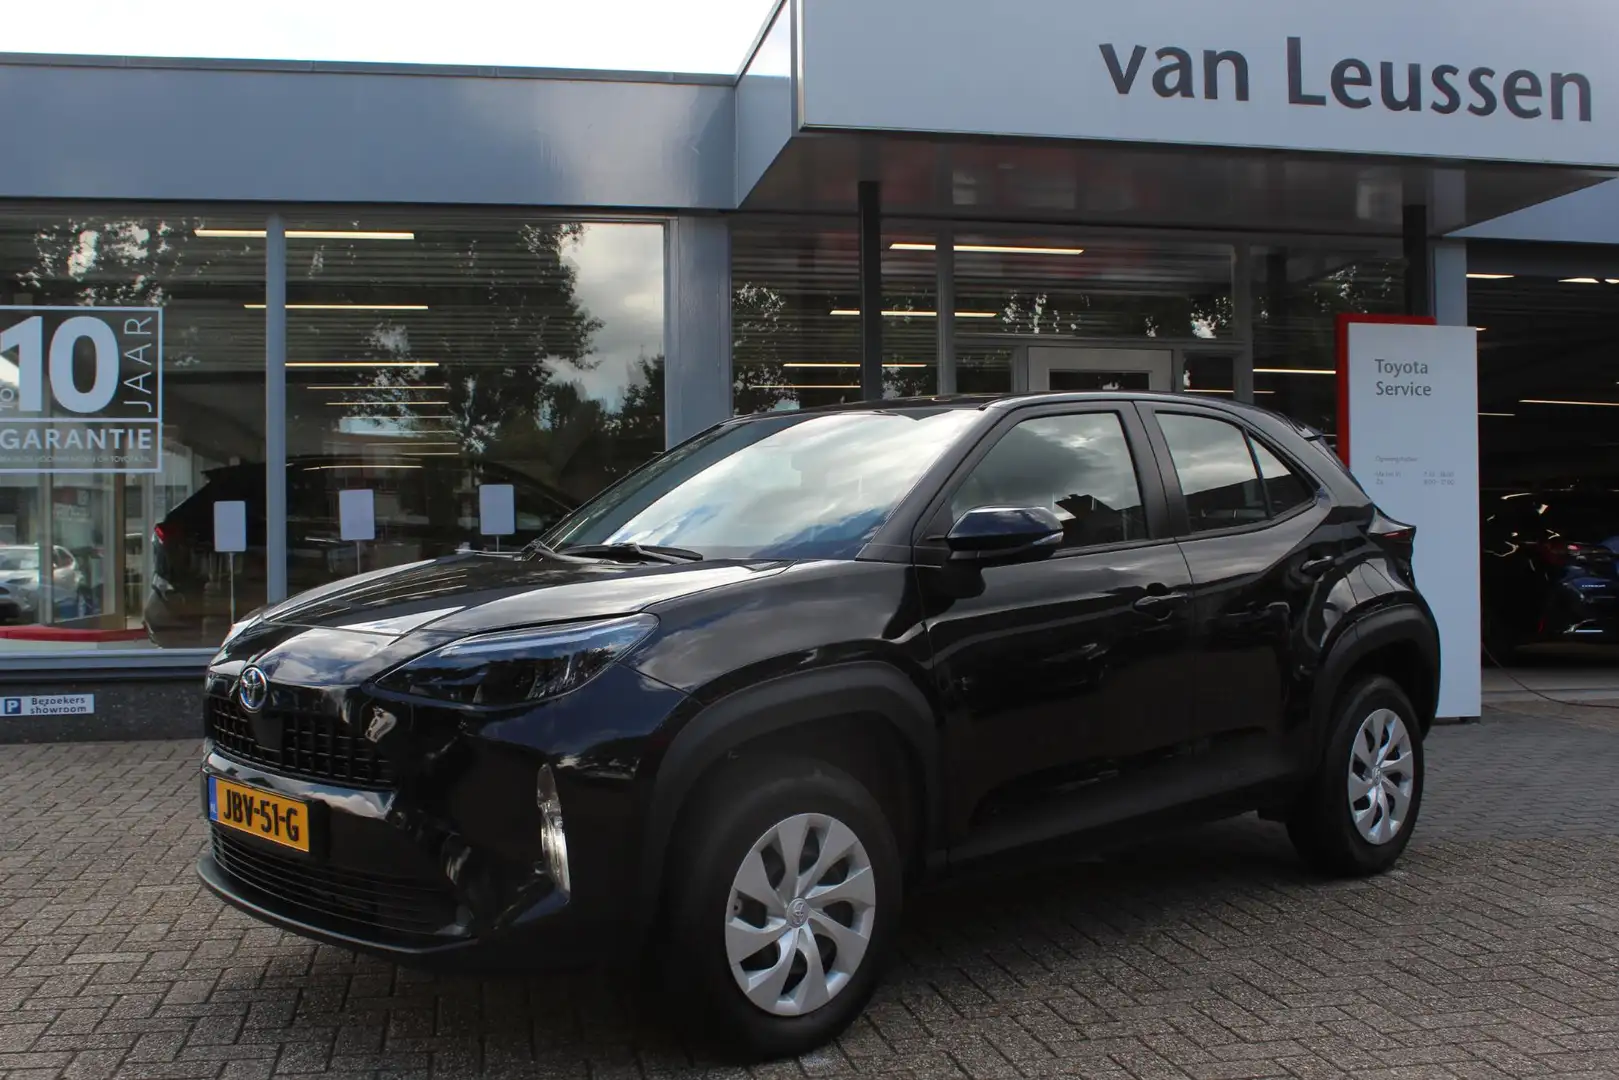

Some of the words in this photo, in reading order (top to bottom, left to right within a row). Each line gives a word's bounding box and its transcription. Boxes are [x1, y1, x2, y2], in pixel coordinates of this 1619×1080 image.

[1099, 43, 1249, 101] van
[1286, 36, 1592, 122] Leussen
[0, 316, 119, 413] 10
[123, 317, 152, 412] JAAR
[1374, 358, 1428, 378] Toyota
[1375, 380, 1432, 396] Service
[0, 428, 152, 450] GARANTIE
[6, 700, 19, 713] P
[30, 705, 87, 714] showroom
[32, 697, 86, 706] Bezoekers
[223, 788, 300, 842] JBV-51-G
